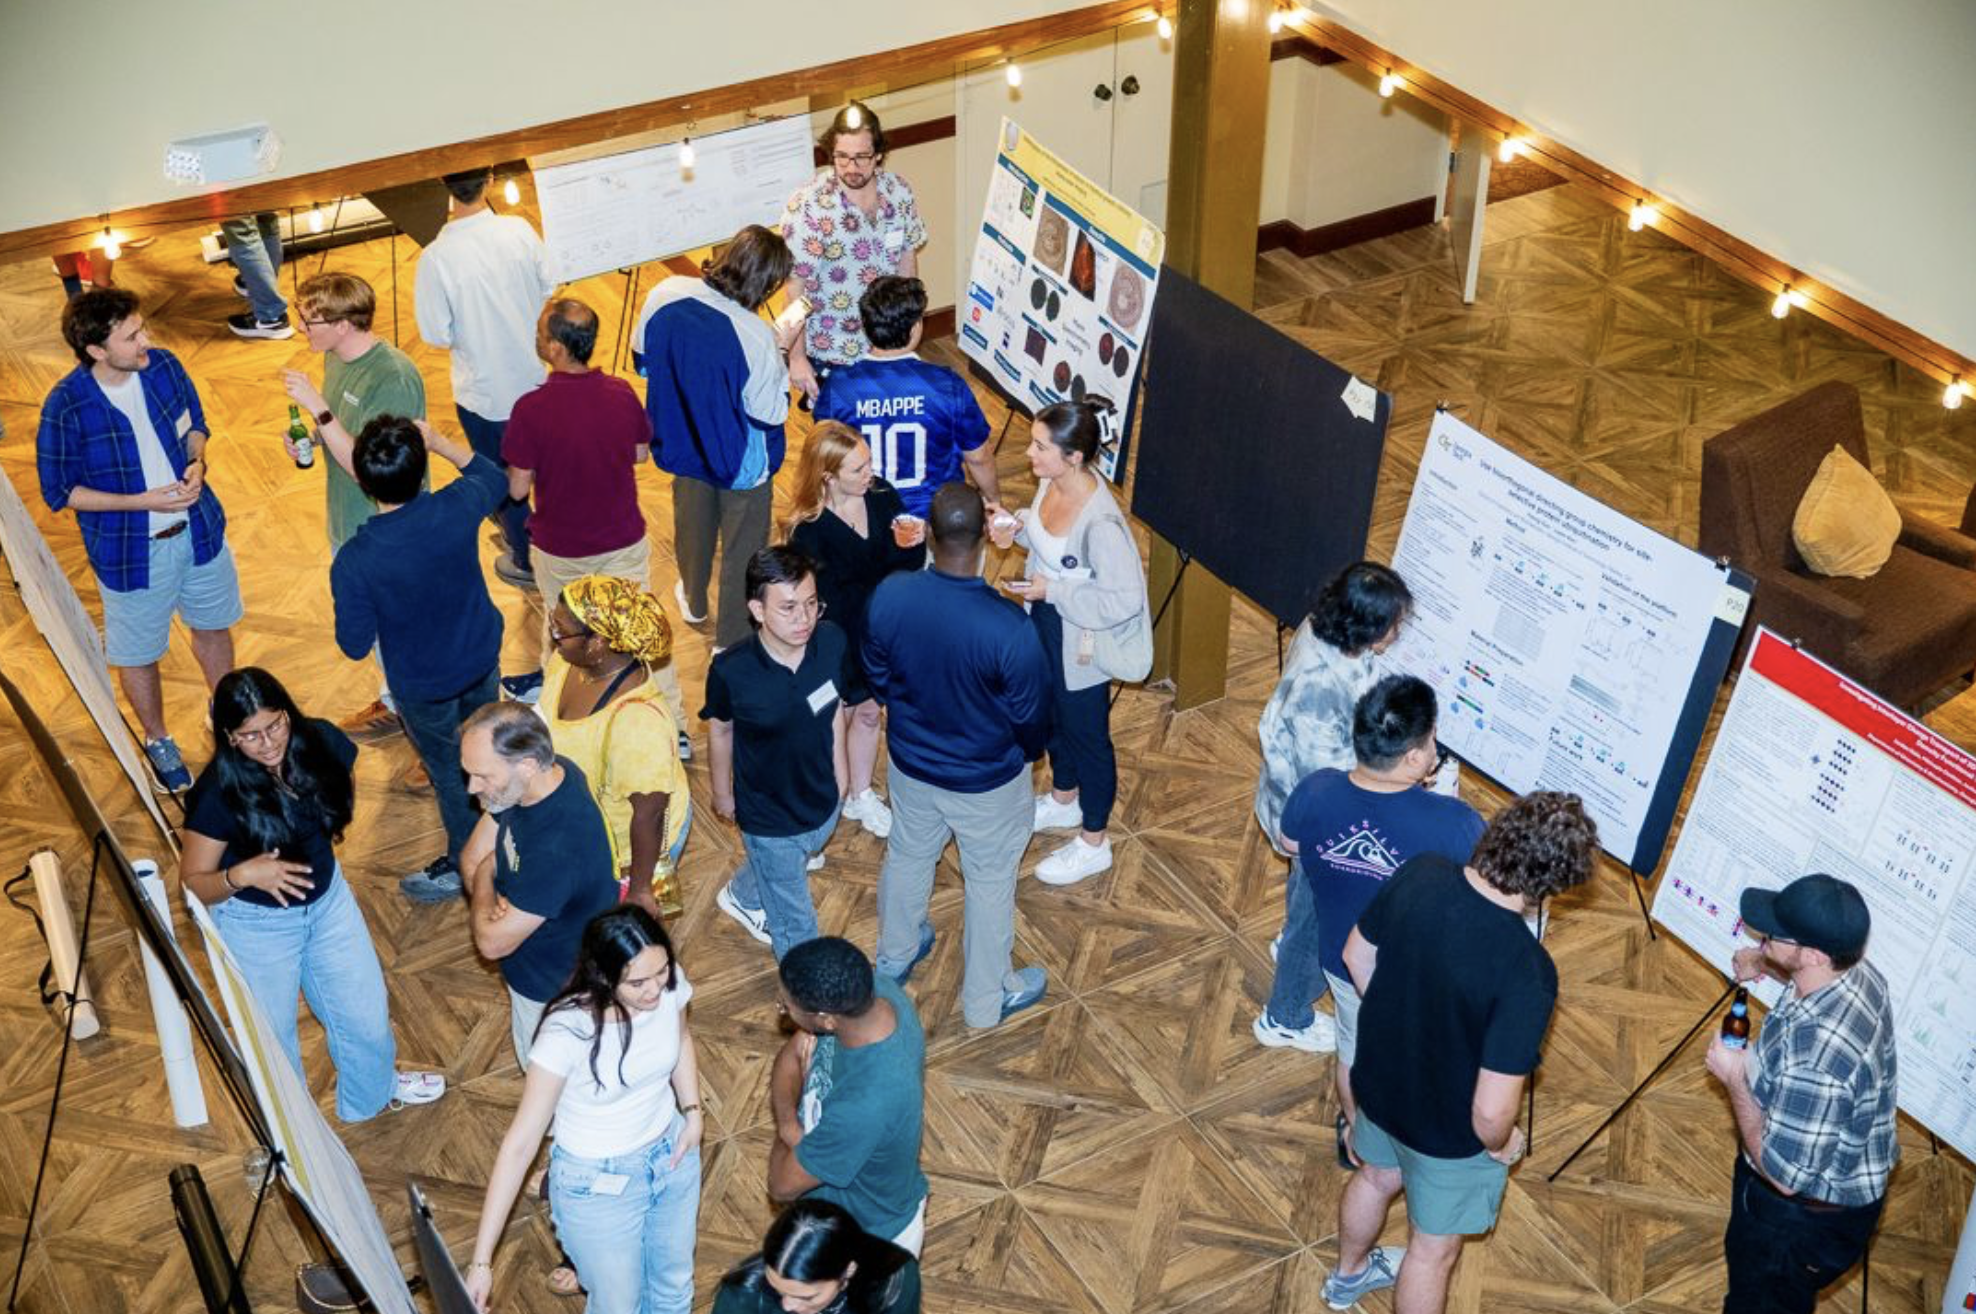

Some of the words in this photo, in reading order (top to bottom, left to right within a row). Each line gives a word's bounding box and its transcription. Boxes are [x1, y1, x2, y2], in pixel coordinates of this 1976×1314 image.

[856, 395, 925, 418] MBAPPE
[861, 422, 927, 489] 10
[1536, 505, 1561, 524] protein
[1536, 492, 1565, 515] directing
[1566, 510, 1586, 527] group
[1587, 521, 1622, 547] chemistry
[1624, 541, 1634, 553] for
[1639, 592, 1652, 604] the
[1727, 597, 1745, 613] P20
